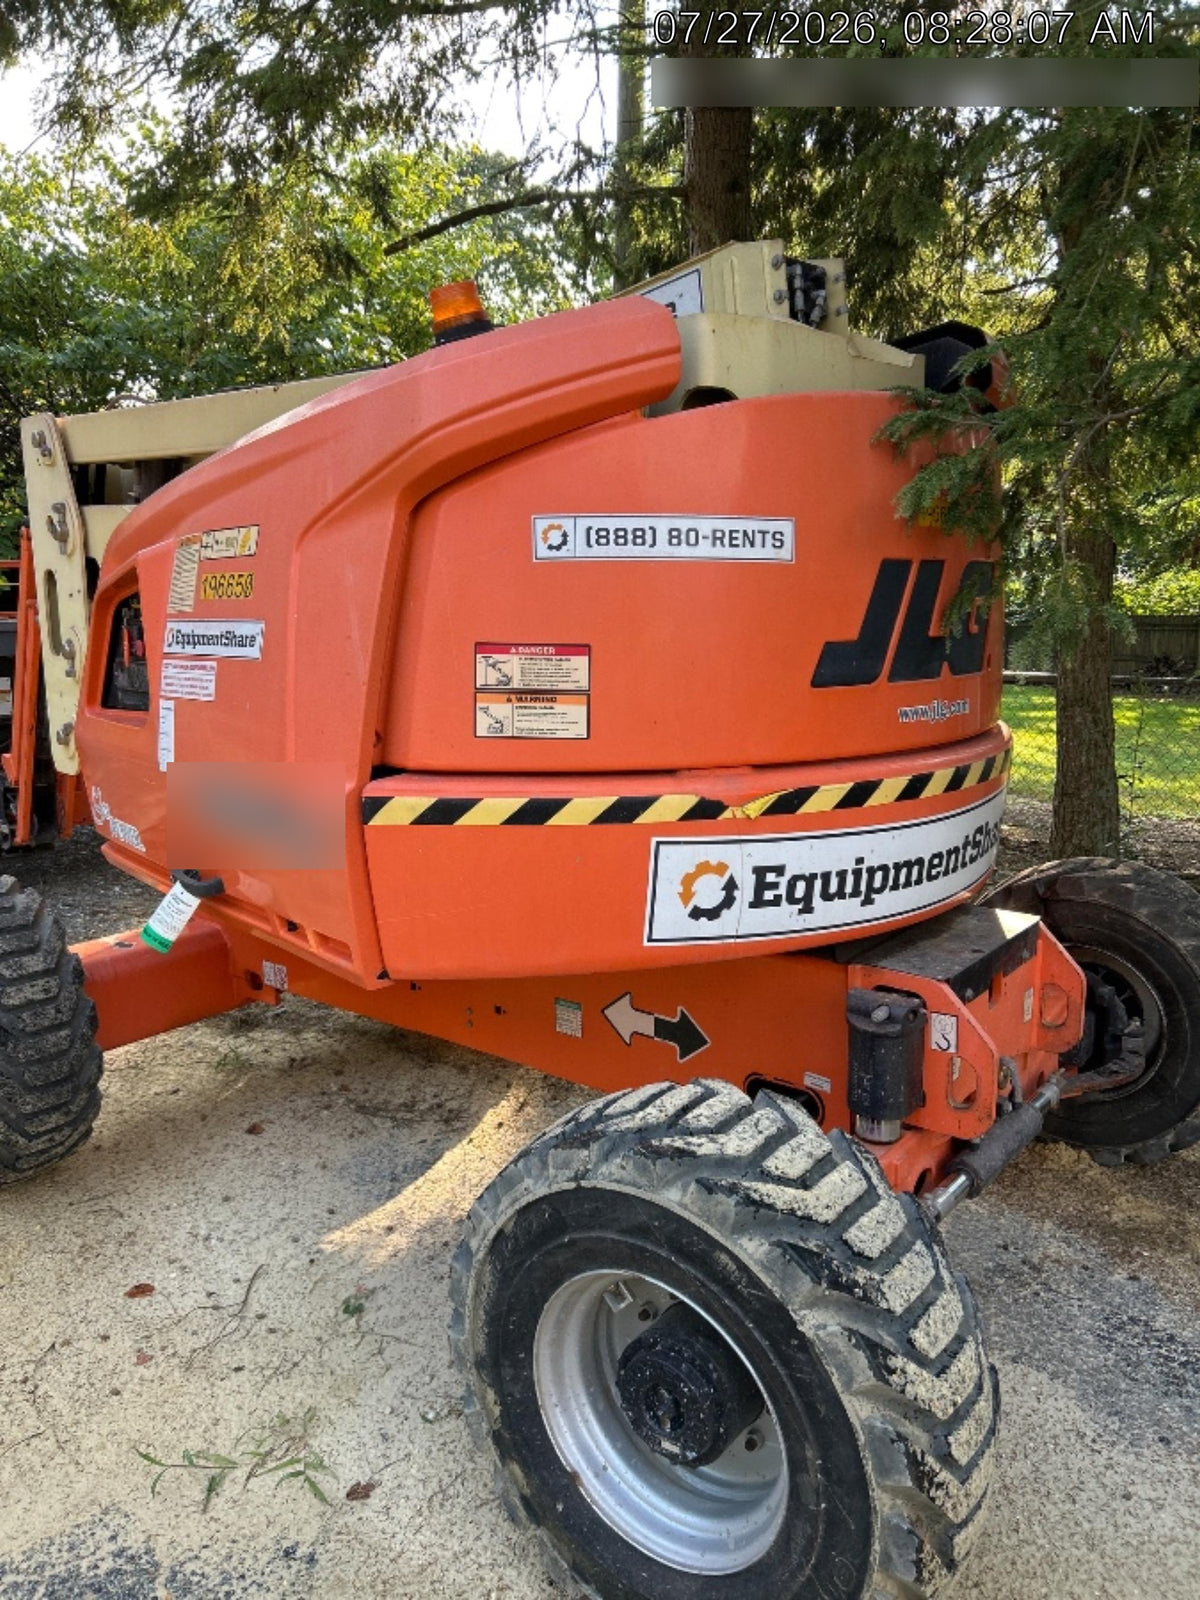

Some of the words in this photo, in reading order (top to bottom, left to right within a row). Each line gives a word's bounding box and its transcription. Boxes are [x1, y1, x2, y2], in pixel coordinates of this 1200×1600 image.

[585, 525, 657, 547] (888)
[667, 527, 785, 549] 80-RENTS
[810, 558, 995, 688] JLG
[175, 629, 256, 649] EquipmentShare
[519, 646, 556, 655] DANGER
[899, 699, 969, 722] www.jlg.com
